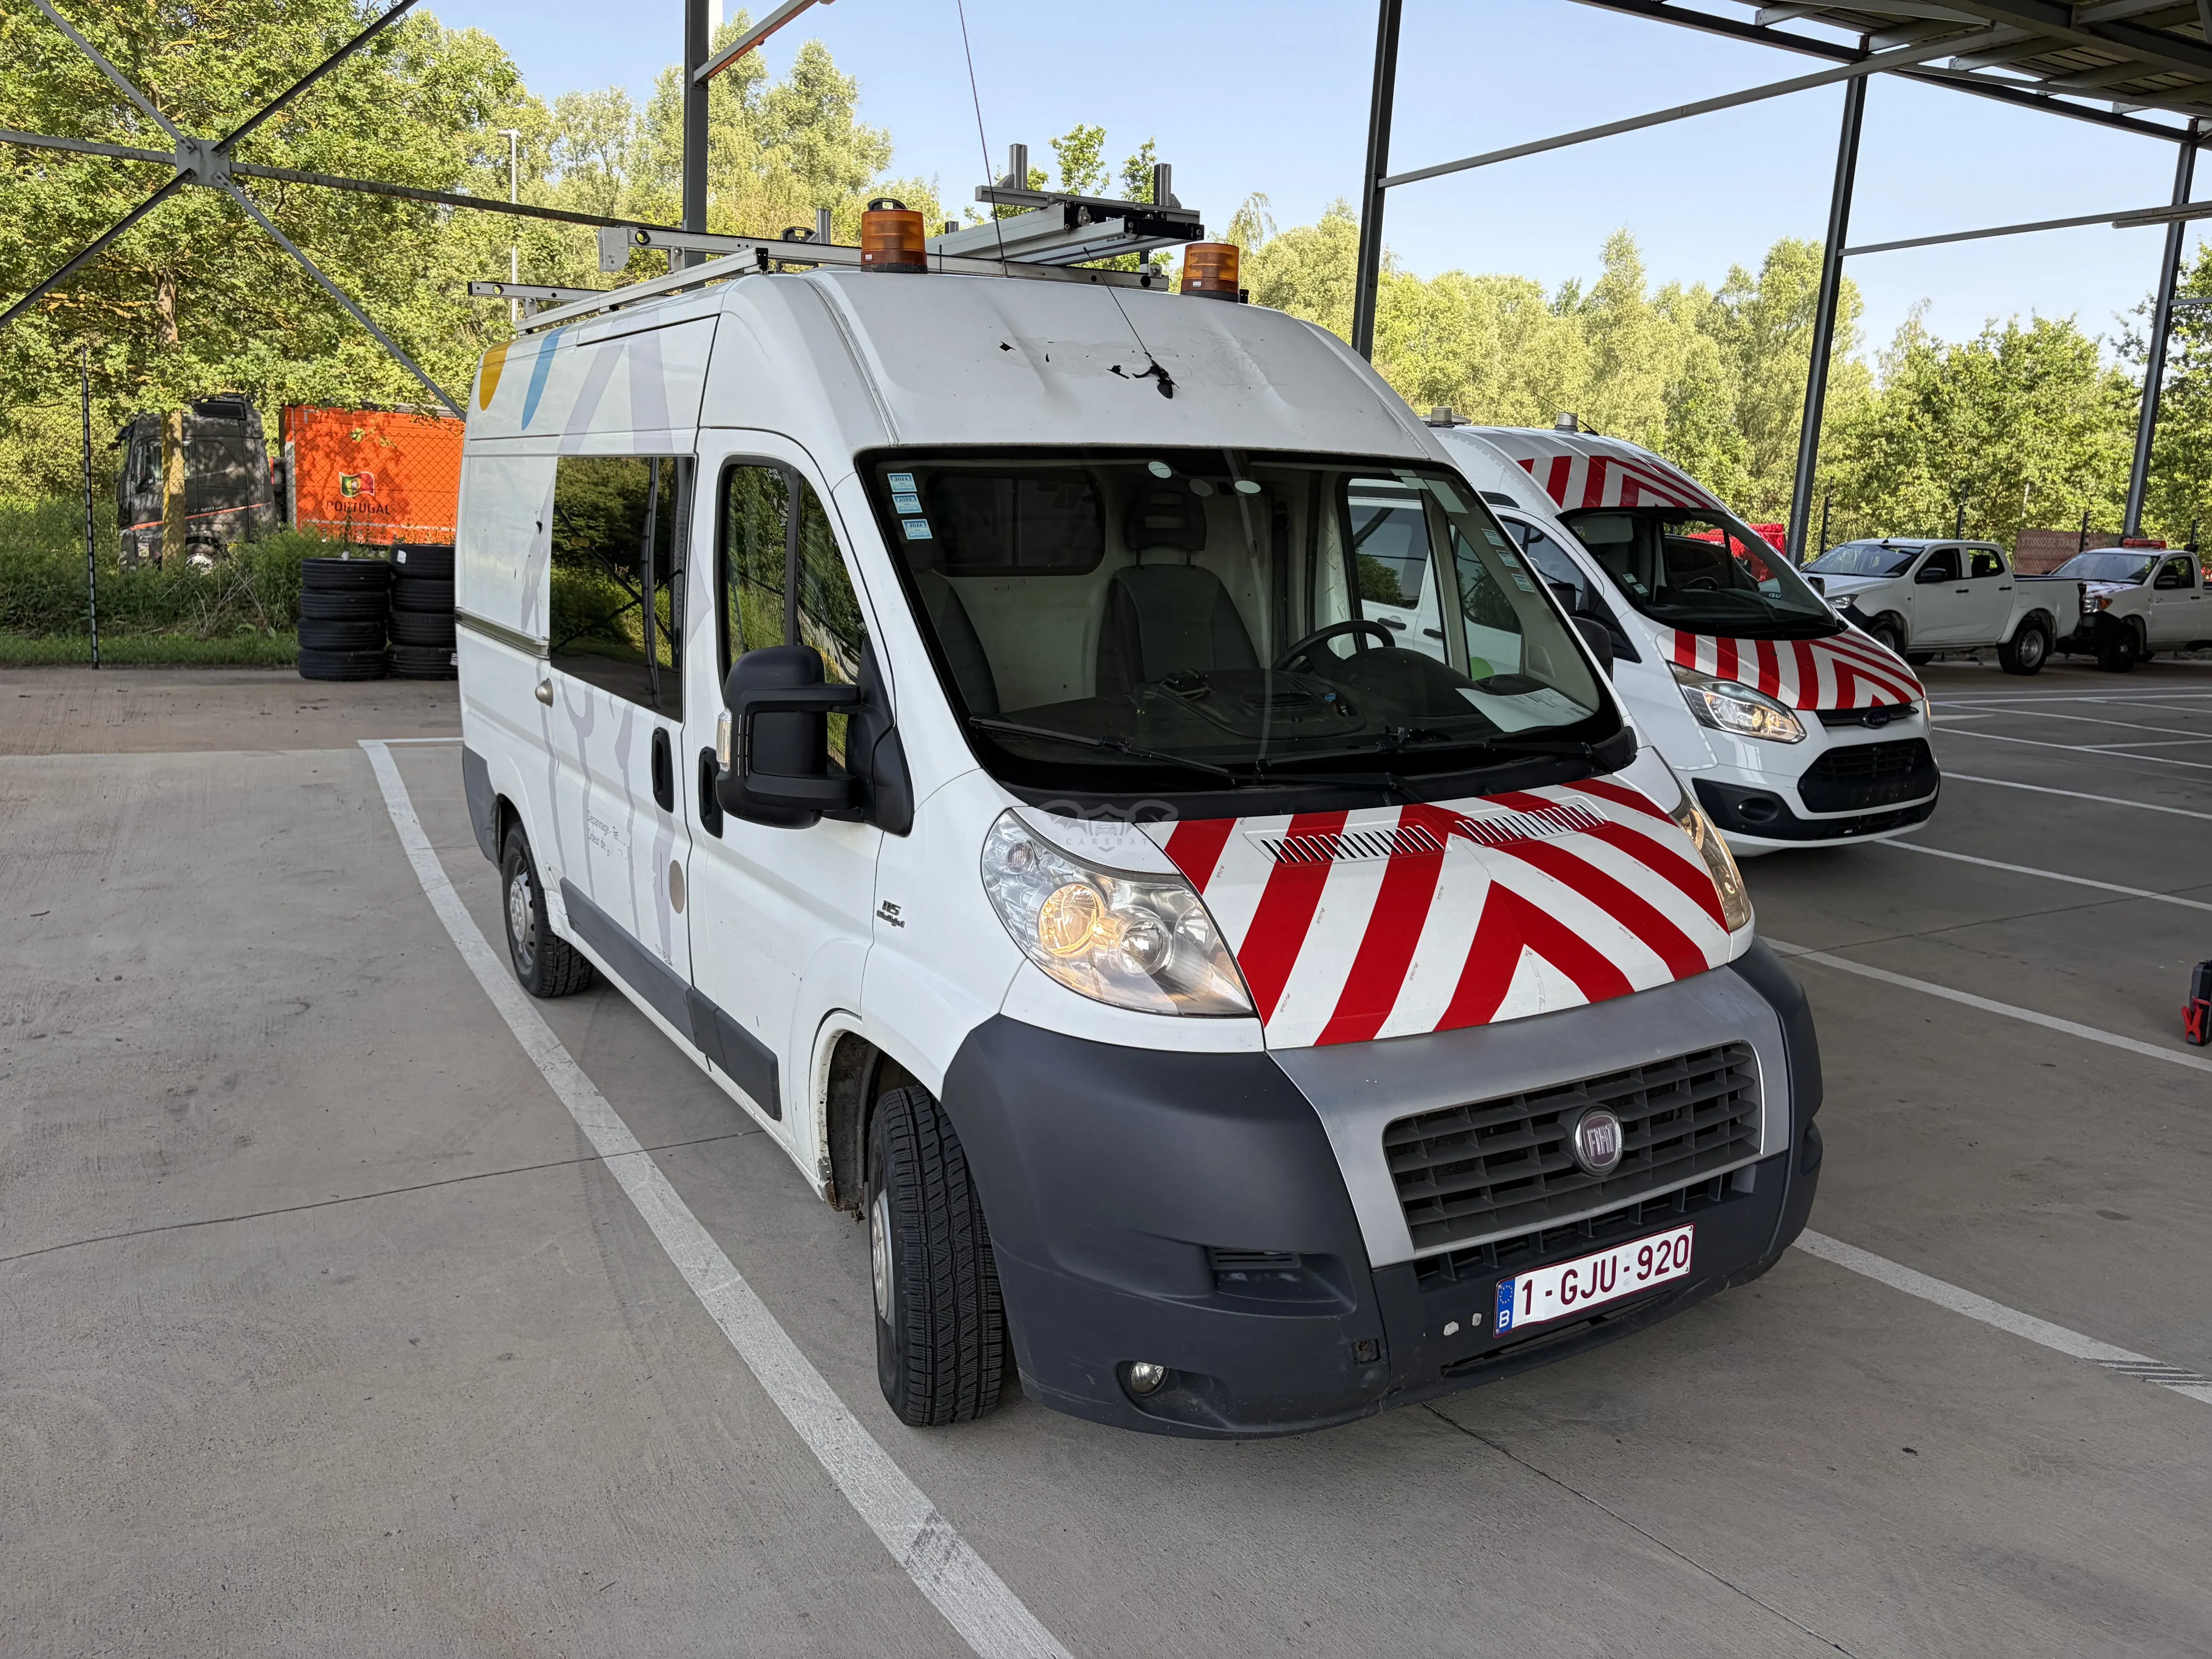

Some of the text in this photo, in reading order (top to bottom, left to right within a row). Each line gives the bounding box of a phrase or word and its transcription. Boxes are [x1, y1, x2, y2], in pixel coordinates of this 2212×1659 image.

[325, 500, 390, 515] PORTUGAL
[1587, 1123, 1614, 1157] FIAT
[1522, 1234, 1690, 1316] 1-GJU-920
[1499, 1309, 1510, 1328] B
